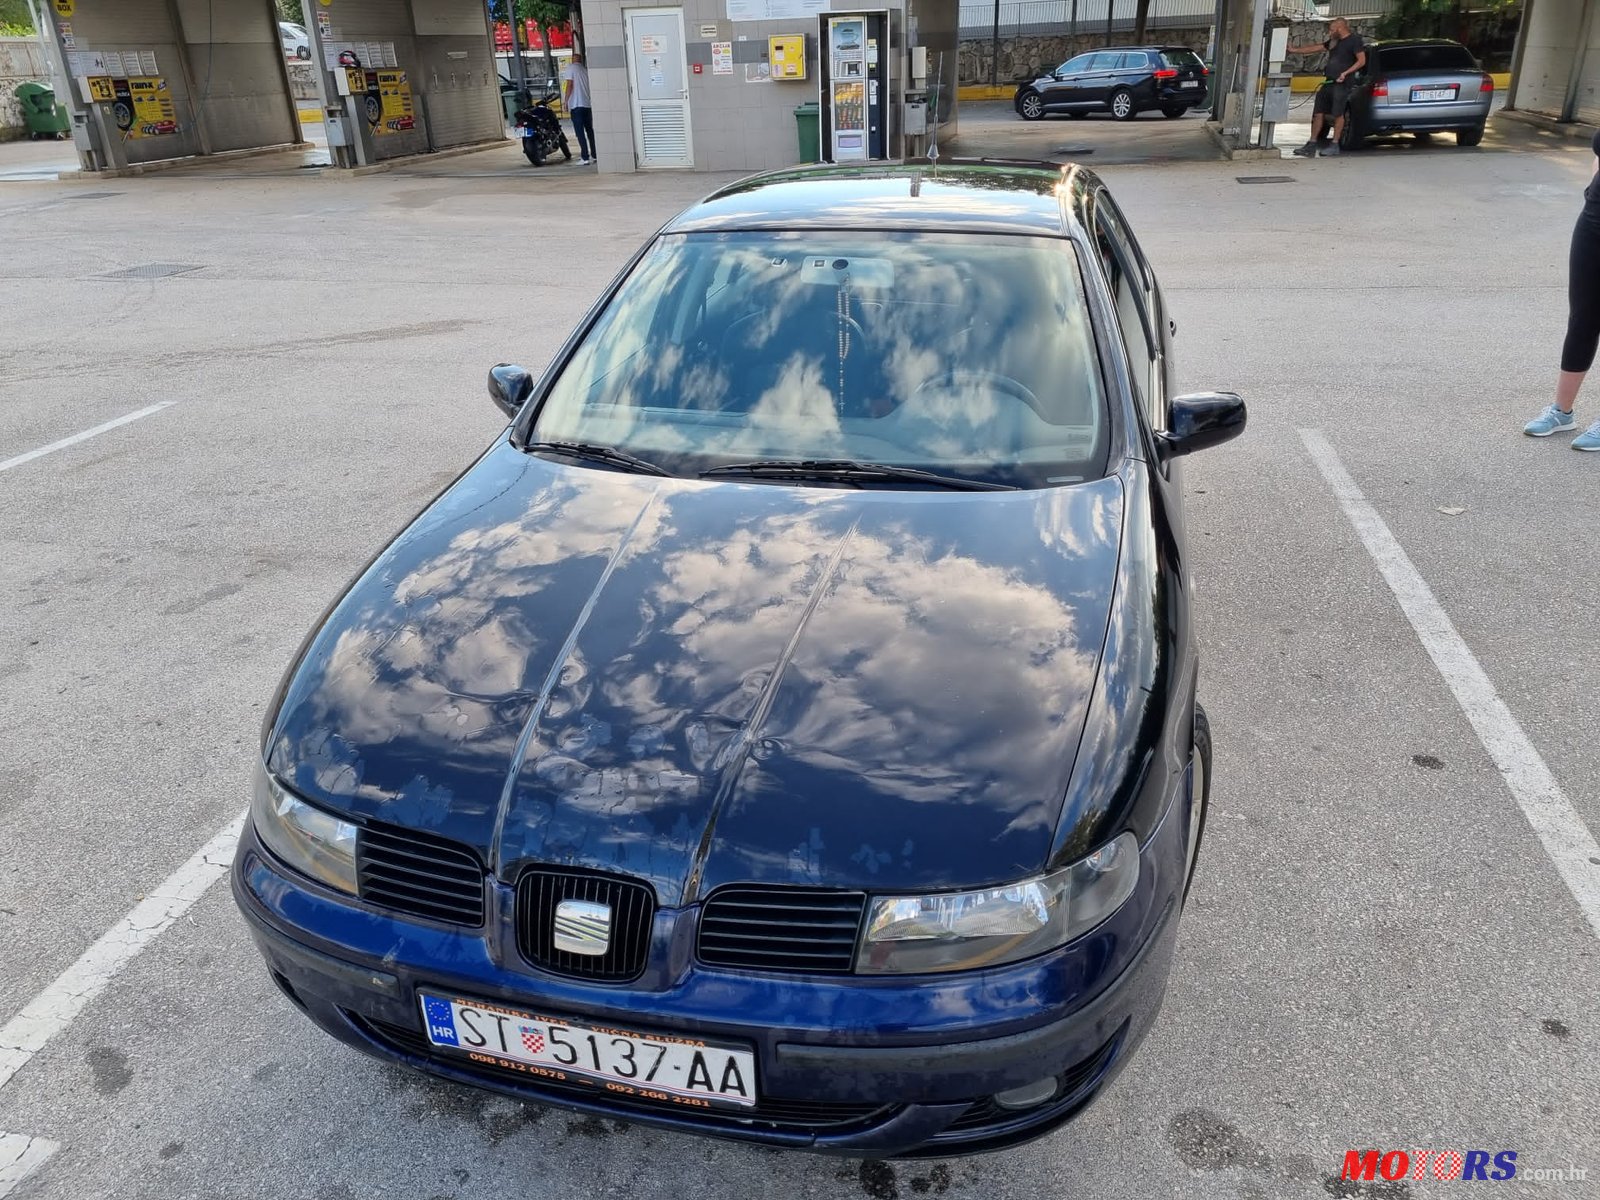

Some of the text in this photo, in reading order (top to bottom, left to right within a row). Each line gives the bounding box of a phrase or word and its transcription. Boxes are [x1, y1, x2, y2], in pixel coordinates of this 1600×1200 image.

[432, 1024, 456, 1040] HR
[459, 1007, 747, 1097] ST 5137-AA
[469, 1052, 567, 1080] 098 912 0575
[605, 1083, 711, 1108] 092 266 2281
